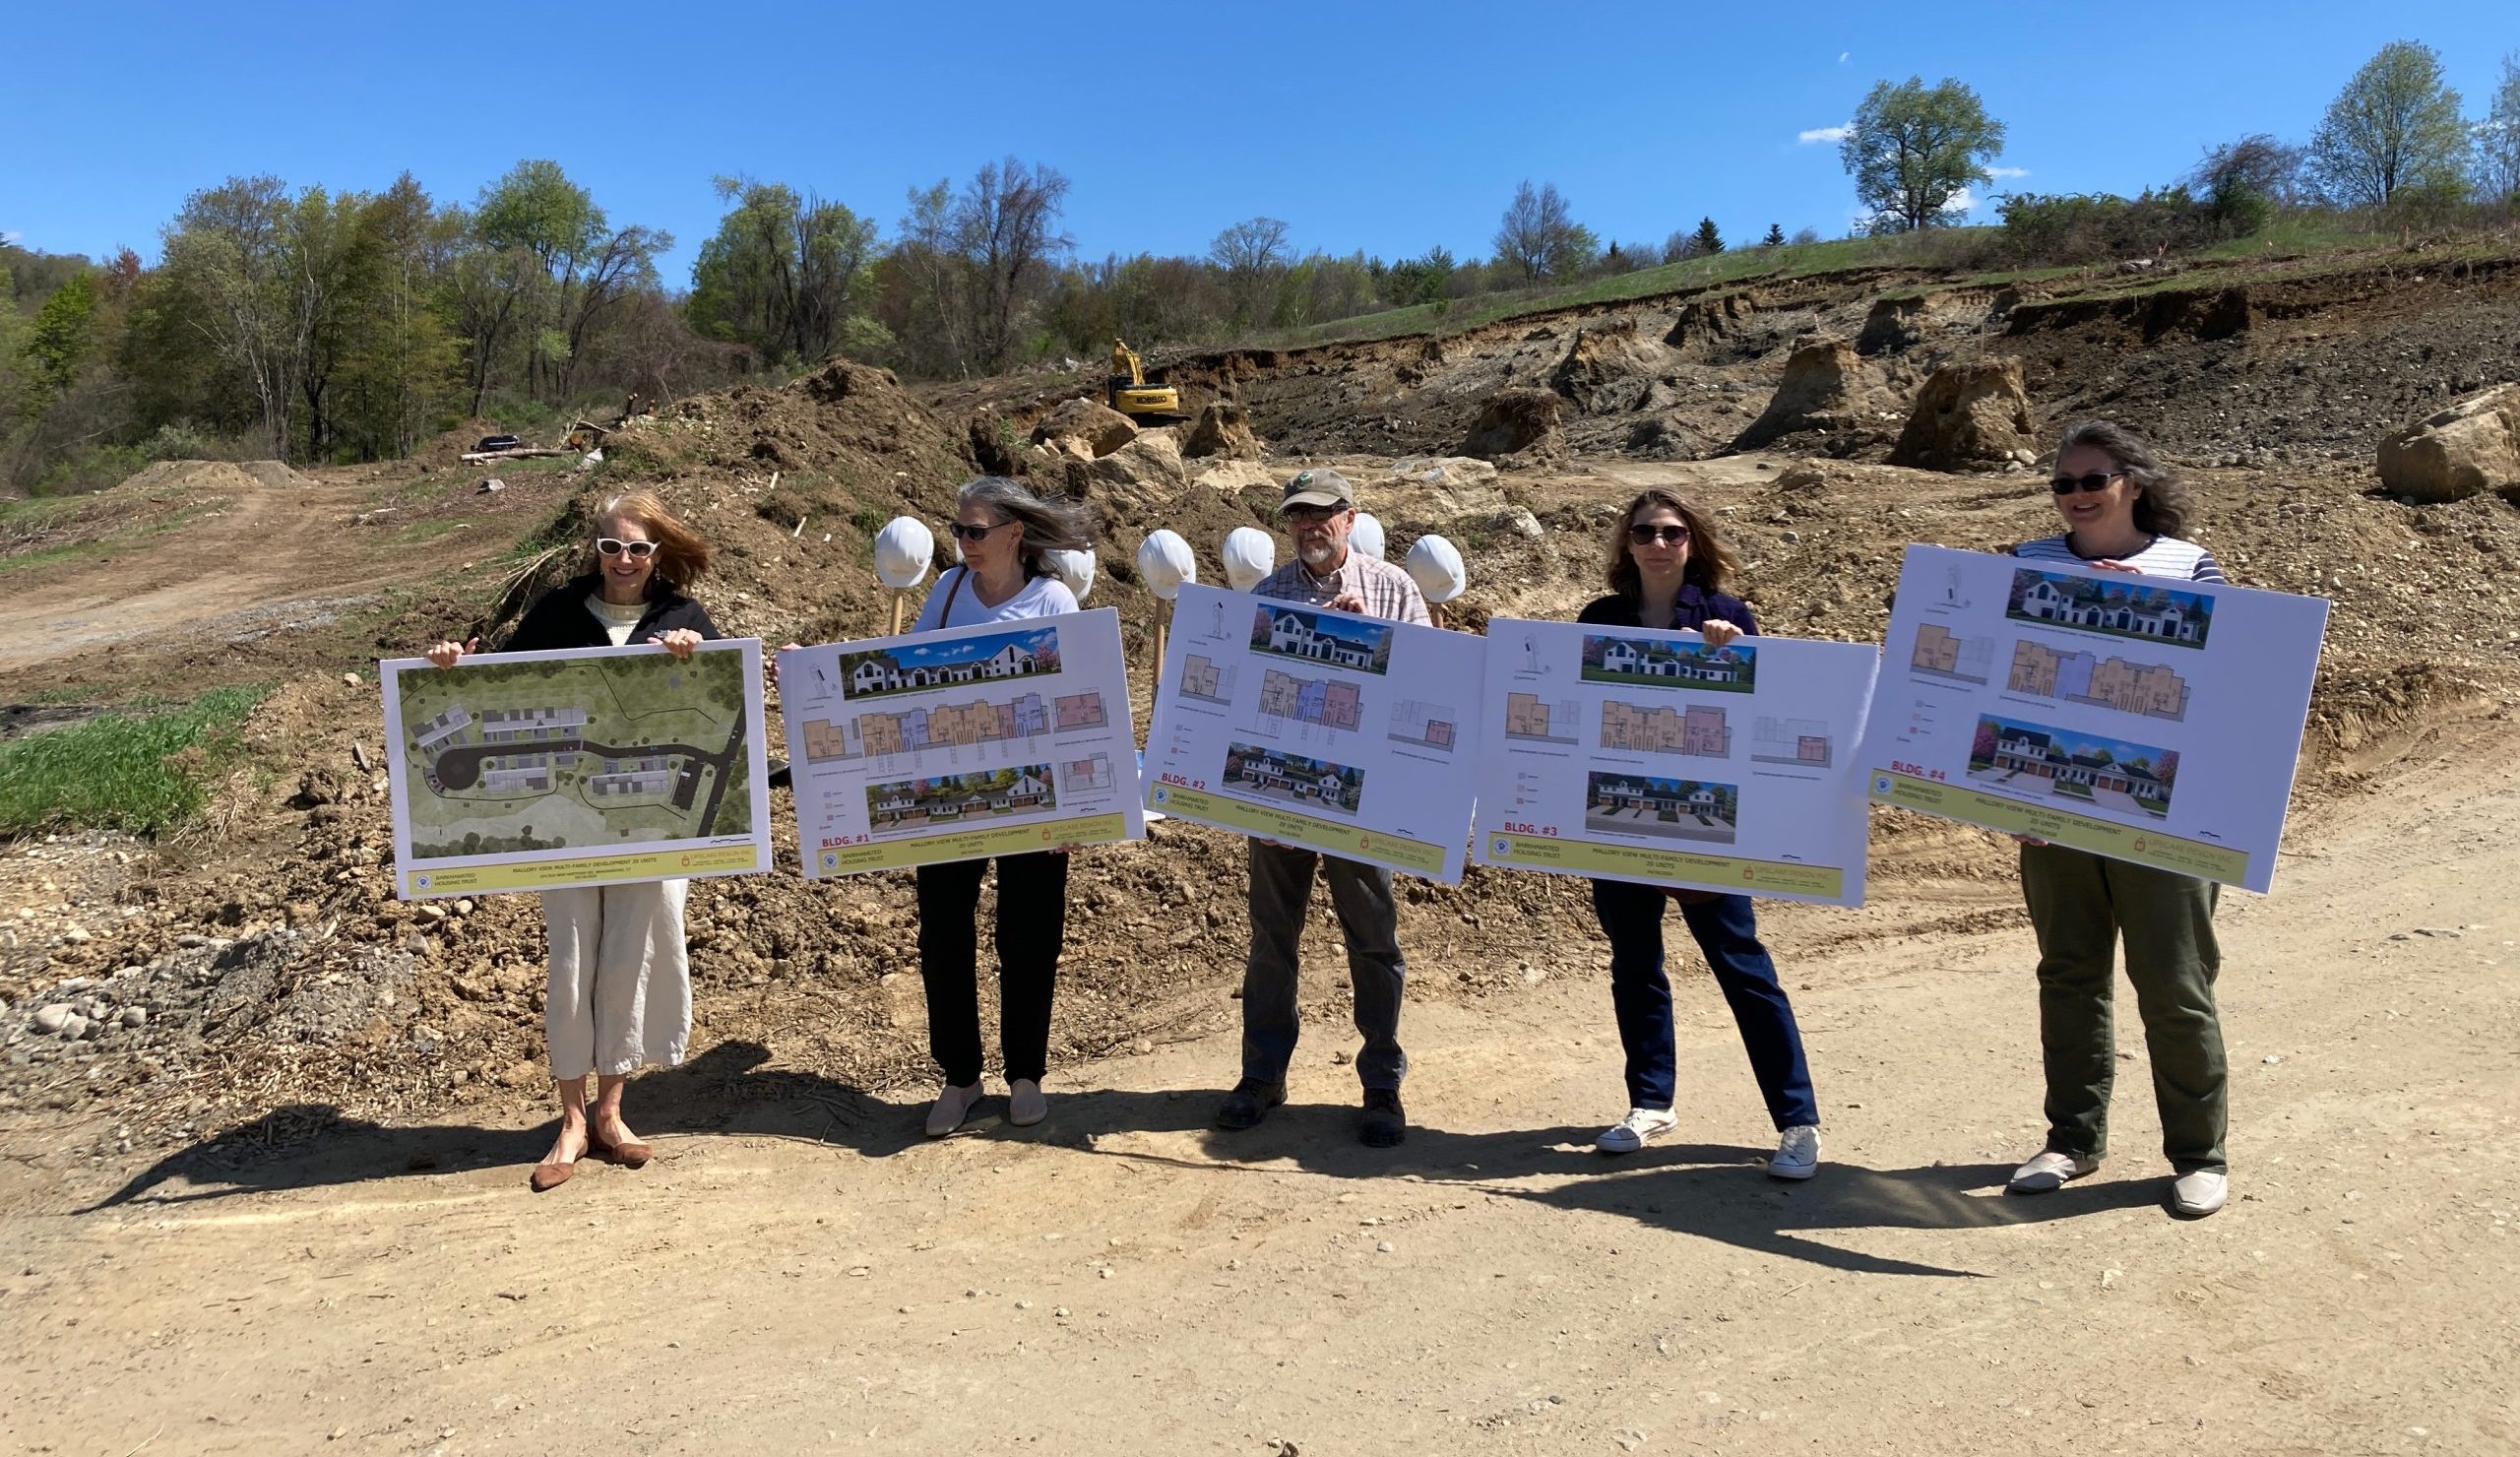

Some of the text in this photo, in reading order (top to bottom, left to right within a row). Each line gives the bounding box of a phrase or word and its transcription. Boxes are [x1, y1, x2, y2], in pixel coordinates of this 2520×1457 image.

[1136, 395, 1167, 404] KOBELCO
[1892, 760, 1946, 781] BLDG. #4
[1162, 772, 1205, 790] BLDG. #2
[1894, 789, 1923, 800] HOUSING
[1169, 798, 1193, 808] HOUSING
[1236, 804, 1259, 814] MALLORY
[1312, 822, 1351, 836] DEVELOPMENT
[2006, 804, 2023, 813] VIEW
[2073, 820, 2122, 836] DEVELOPMENT
[2040, 820, 2061, 830] UNITS
[991, 828, 1030, 838] DEVELOPMENT
[1504, 822, 1557, 837] BLDG. #3
[822, 836, 852, 847] BLDG.
[1593, 848, 1619, 856] MALLORY
[1684, 857, 1730, 868] DEVELOPMENT
